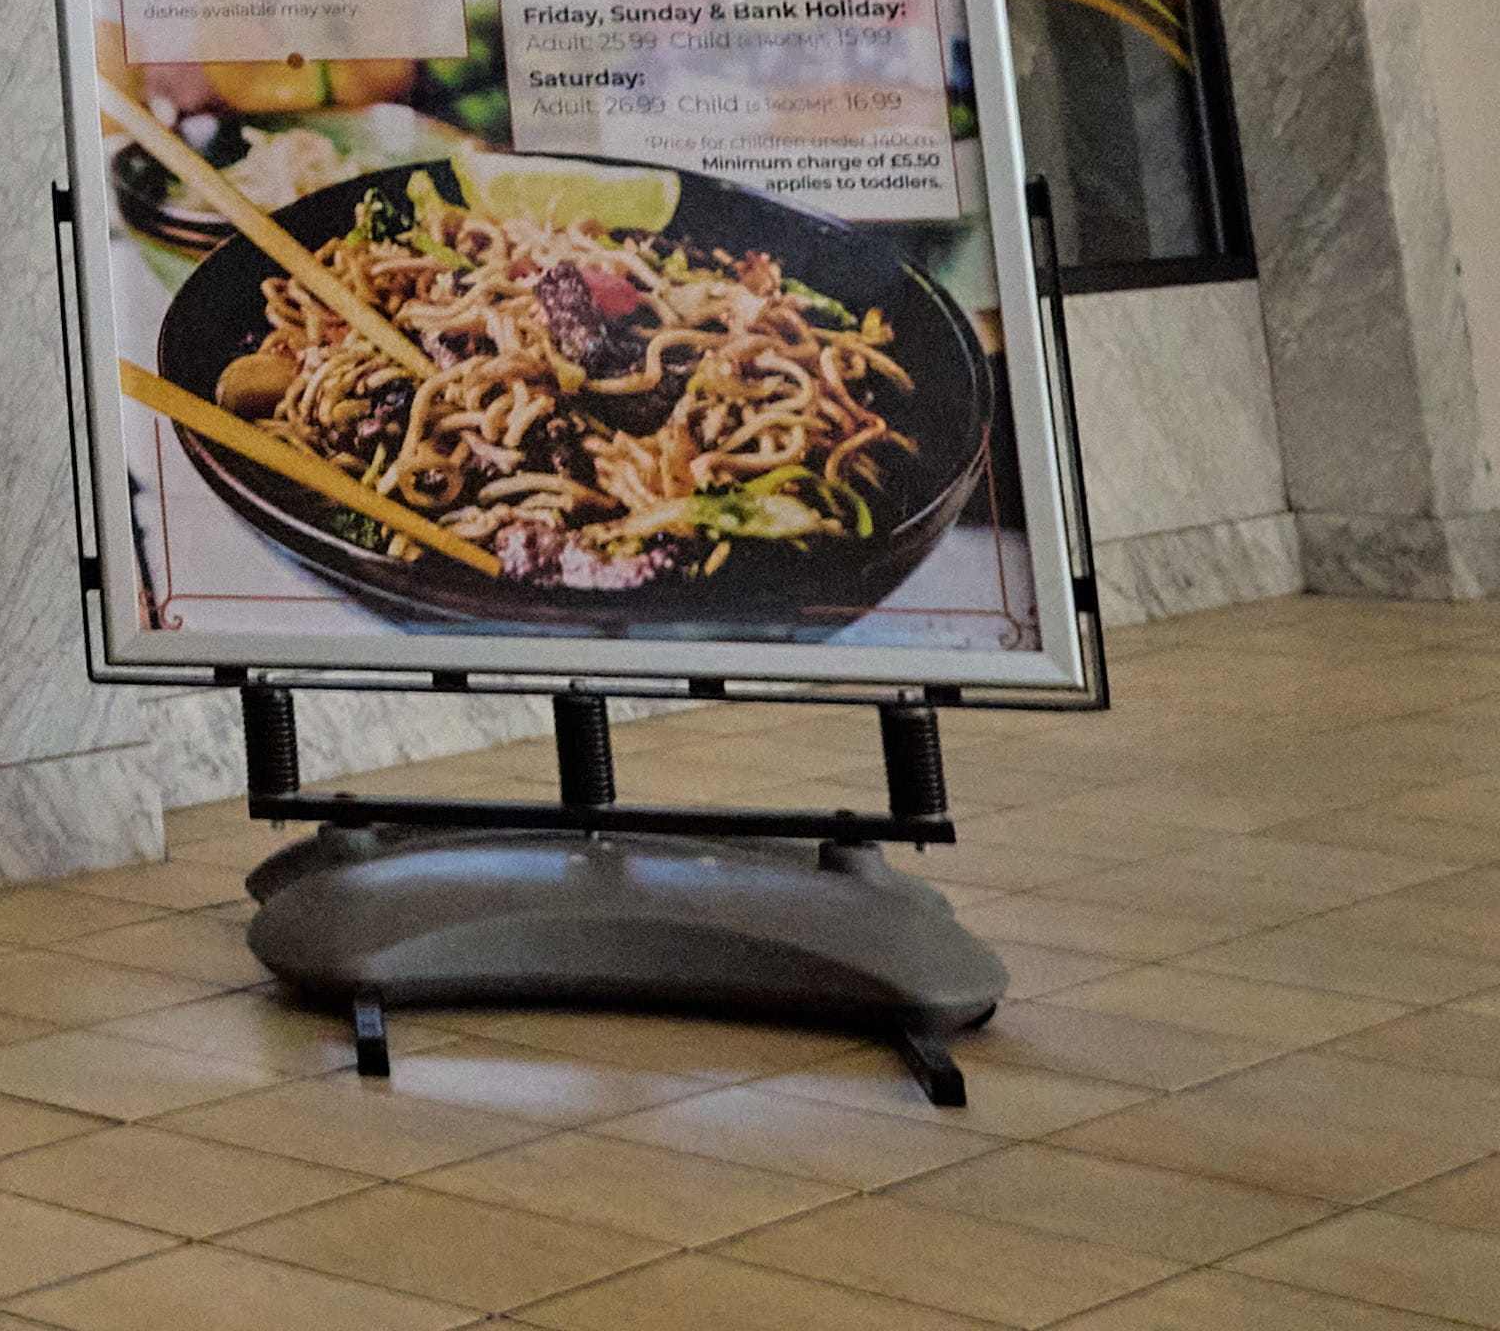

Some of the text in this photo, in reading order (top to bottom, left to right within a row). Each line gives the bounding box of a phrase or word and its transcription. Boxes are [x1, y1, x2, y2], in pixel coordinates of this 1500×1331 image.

[143, 5, 198, 20] dishes
[201, 2, 276, 20] available
[281, 4, 318, 20] may
[523, 5, 605, 27] Friday,
[611, 3, 702, 26] Sunday
[709, 3, 726, 20] &
[734, 1, 797, 21] Bank
[670, 29, 731, 51] Child
[529, 69, 645, 91] Saturday:
[678, 93, 739, 114] Child
[844, 90, 903, 112] 16.99
[701, 135, 725, 150] for
[729, 135, 804, 150] children
[808, 134, 866, 148] under
[702, 152, 940, 172] Minimum charge of £5.50
[765, 175, 832, 192] applies
[837, 175, 856, 190] to
